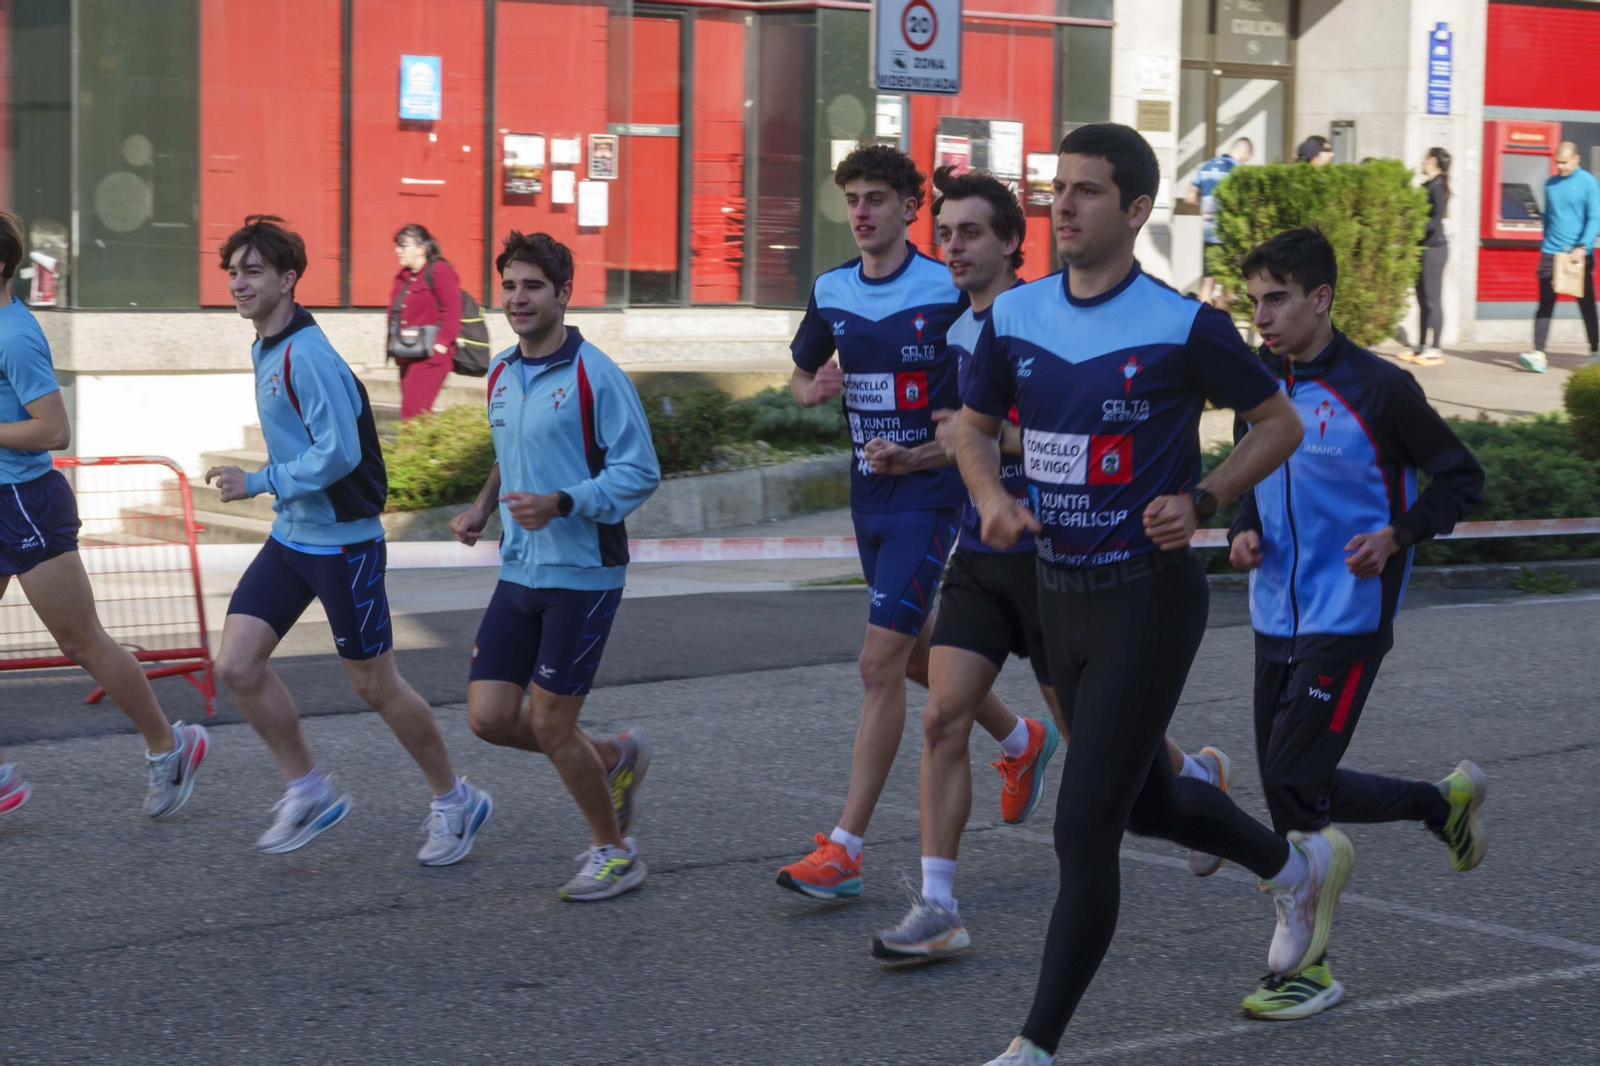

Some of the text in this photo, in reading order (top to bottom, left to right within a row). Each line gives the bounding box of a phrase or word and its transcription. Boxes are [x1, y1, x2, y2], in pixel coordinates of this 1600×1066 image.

[908, 16, 930, 33] 20
[914, 57, 946, 70] ZONA
[901, 345, 935, 357] CELTA
[849, 393, 883, 404] DE VIGO
[1102, 399, 1149, 414] CELTA
[863, 417, 900, 429] XUNTA
[877, 428, 928, 442] GALICIA
[1027, 439, 1080, 457] CONCELLO
[1030, 458, 1070, 474] DE VIGO
[1041, 492, 1090, 509] XUNTA
[1041, 509, 1128, 528] DE GALICIA
